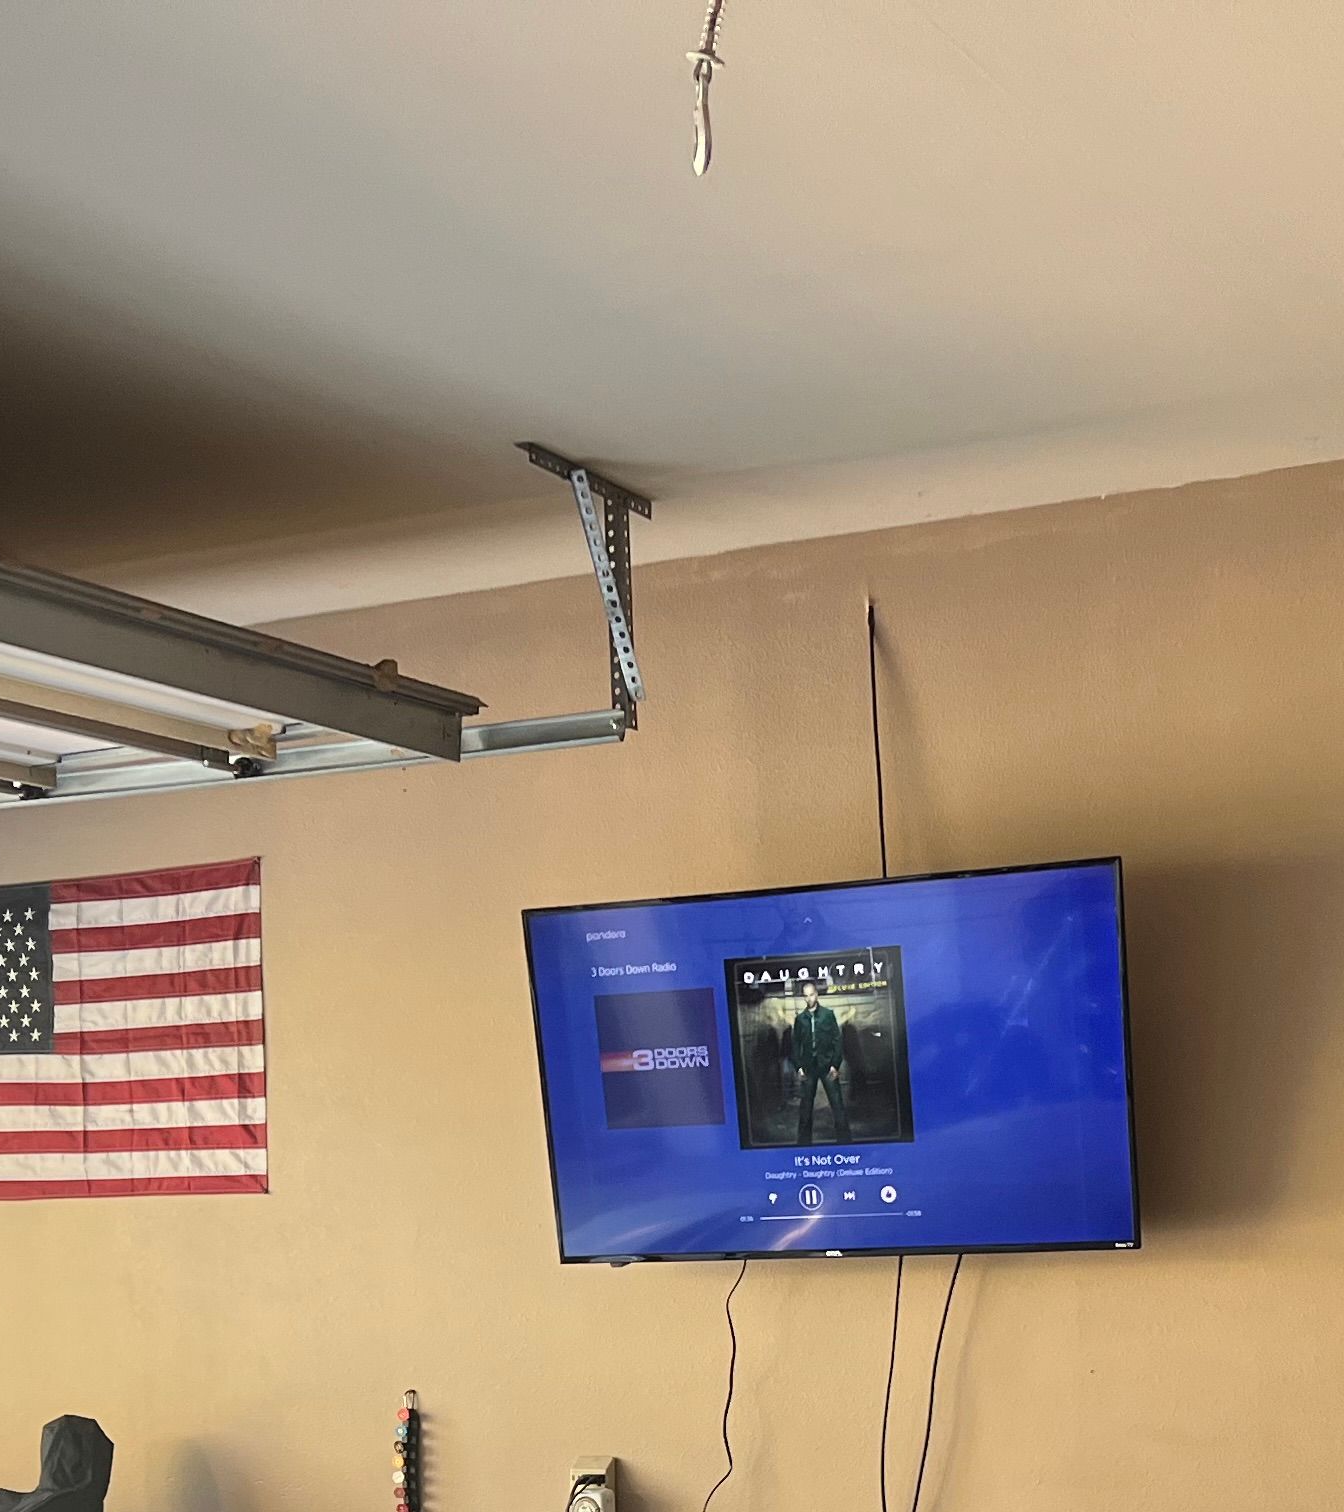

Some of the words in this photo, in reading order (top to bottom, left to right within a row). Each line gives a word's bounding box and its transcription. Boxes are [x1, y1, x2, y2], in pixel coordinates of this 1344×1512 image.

[586, 930, 626, 943] pandora
[591, 966, 597, 978] 3
[598, 966, 625, 977] Doors
[626, 964, 651, 975] Down
[652, 962, 677, 973] Radio
[743, 961, 883, 984] DAUGHTRY
[632, 1049, 655, 1071] 3
[654, 1045, 709, 1059] DOORS
[655, 1056, 710, 1069] DOWN
[812, 1154, 831, 1166] Not
[834, 1154, 861, 1165] Over
[765, 1171, 797, 1181] Daughtry
[803, 1169, 835, 1179] Daughtry
